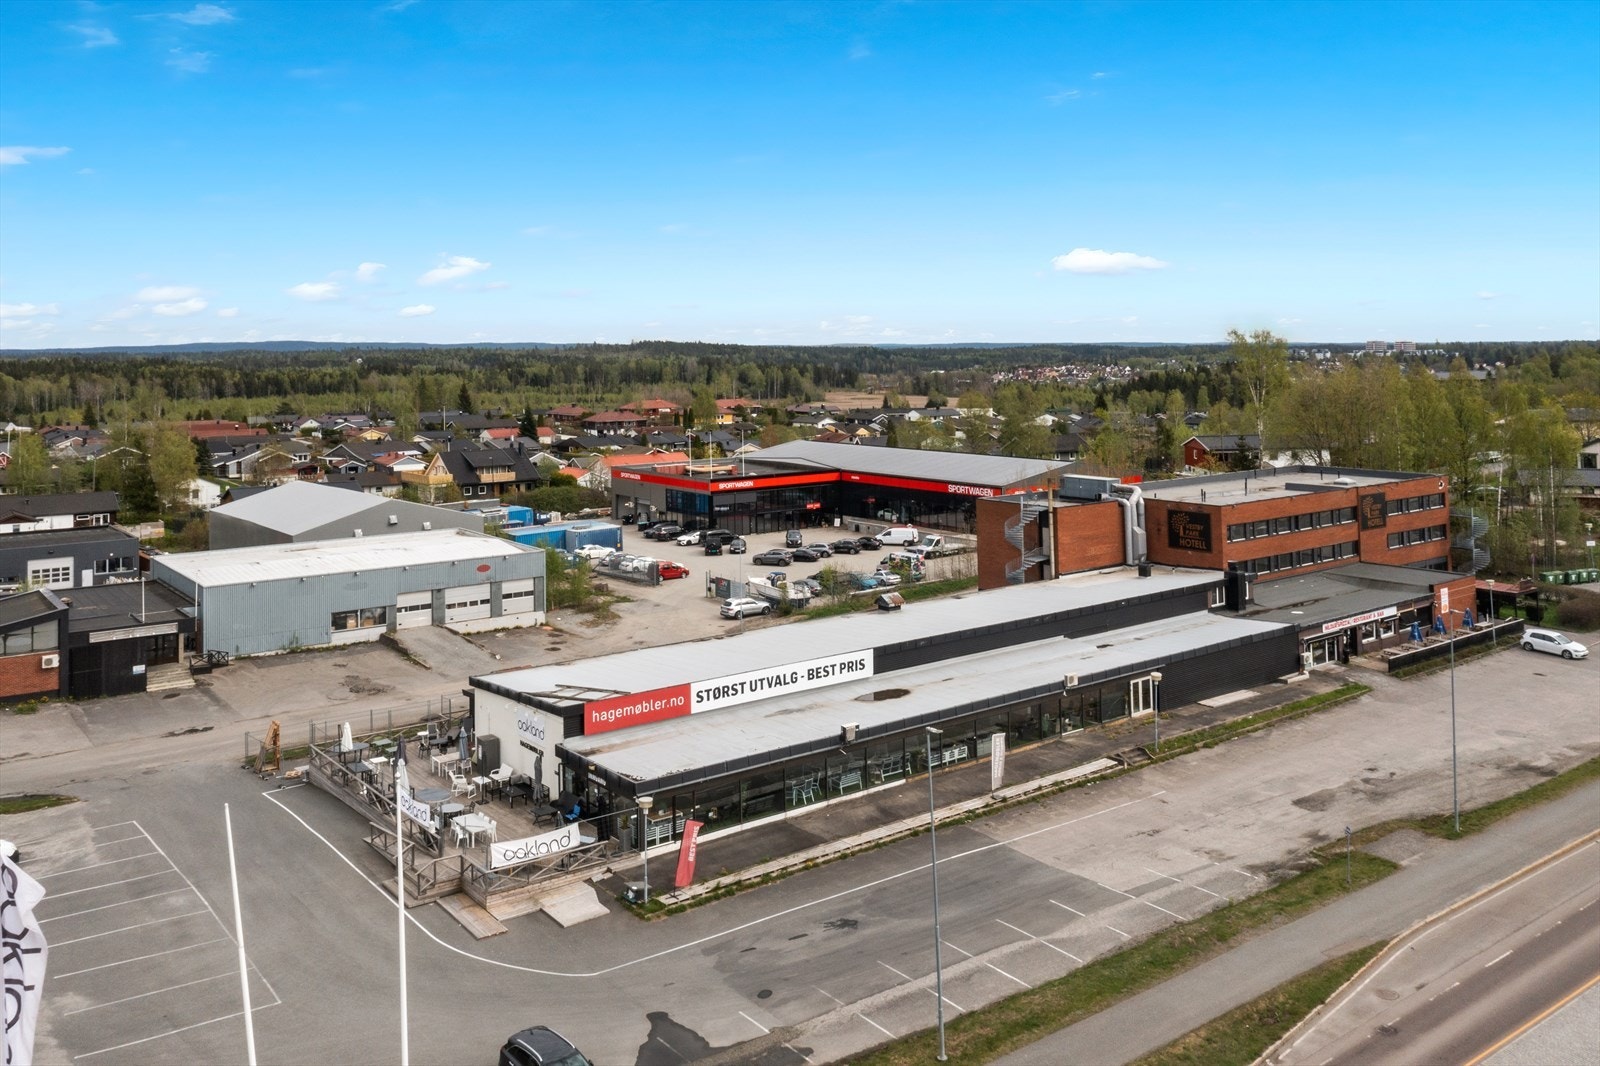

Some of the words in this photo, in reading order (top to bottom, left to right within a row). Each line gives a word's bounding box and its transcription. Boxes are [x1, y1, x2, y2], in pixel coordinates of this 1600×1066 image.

[719, 481, 754, 490] SPORTWAGEN
[948, 484, 993, 497] SPORTWAGEN
[1180, 537, 1207, 549] HOTELL
[696, 681, 747, 704] STØRST
[749, 671, 798, 693] UTVALG
[807, 664, 837, 681] BEST
[839, 658, 866, 675] PRIS
[592, 696, 685, 723] hagemøbler.no
[518, 719, 545, 740] oakland
[401, 795, 427, 822] oakland
[504, 830, 571, 861] oakland
